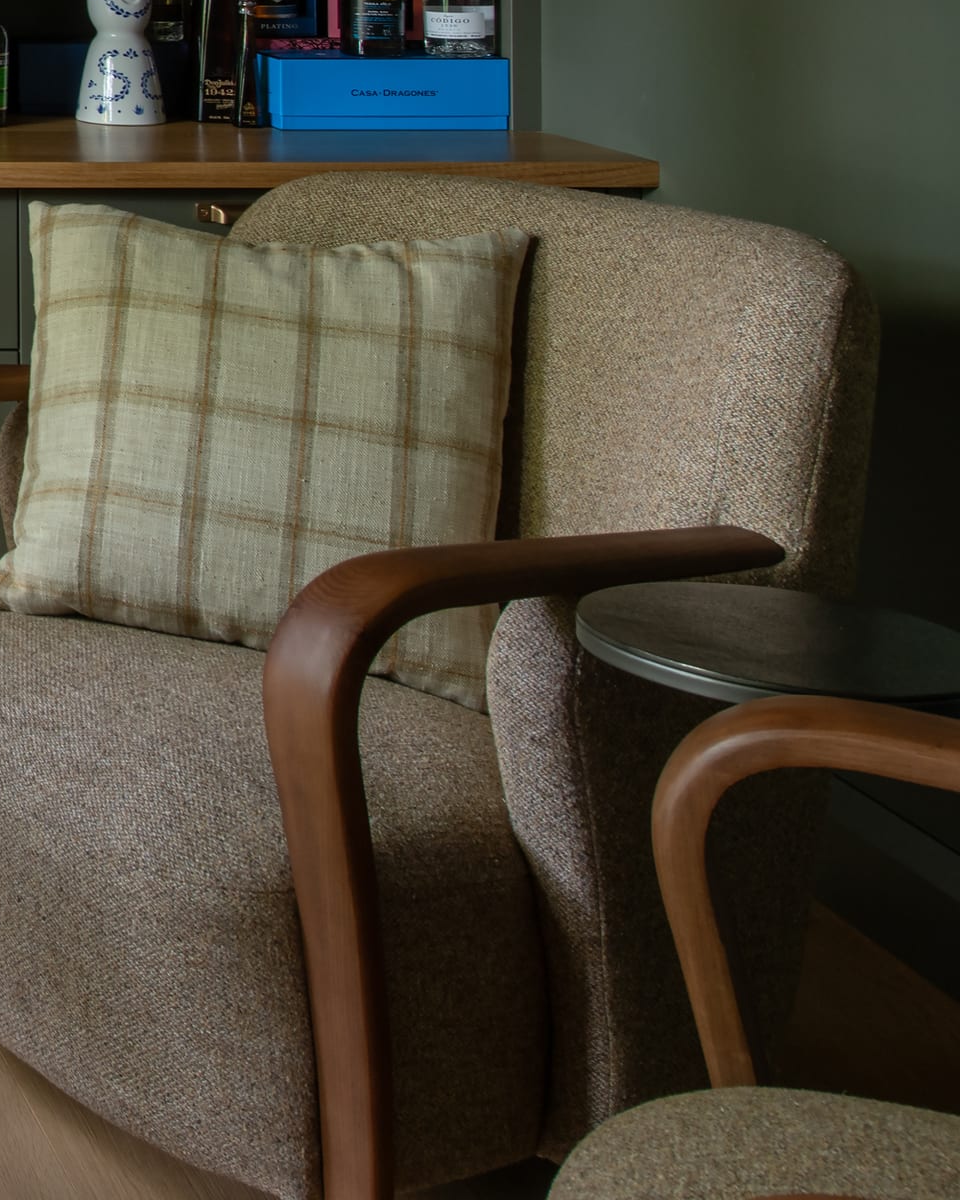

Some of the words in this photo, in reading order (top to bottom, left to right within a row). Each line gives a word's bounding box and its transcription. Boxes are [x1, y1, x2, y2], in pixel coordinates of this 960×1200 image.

[260, 22, 300, 31] PLATINO
[351, 88, 379, 97] CASA
[382, 88, 439, 97] DRAGONES
